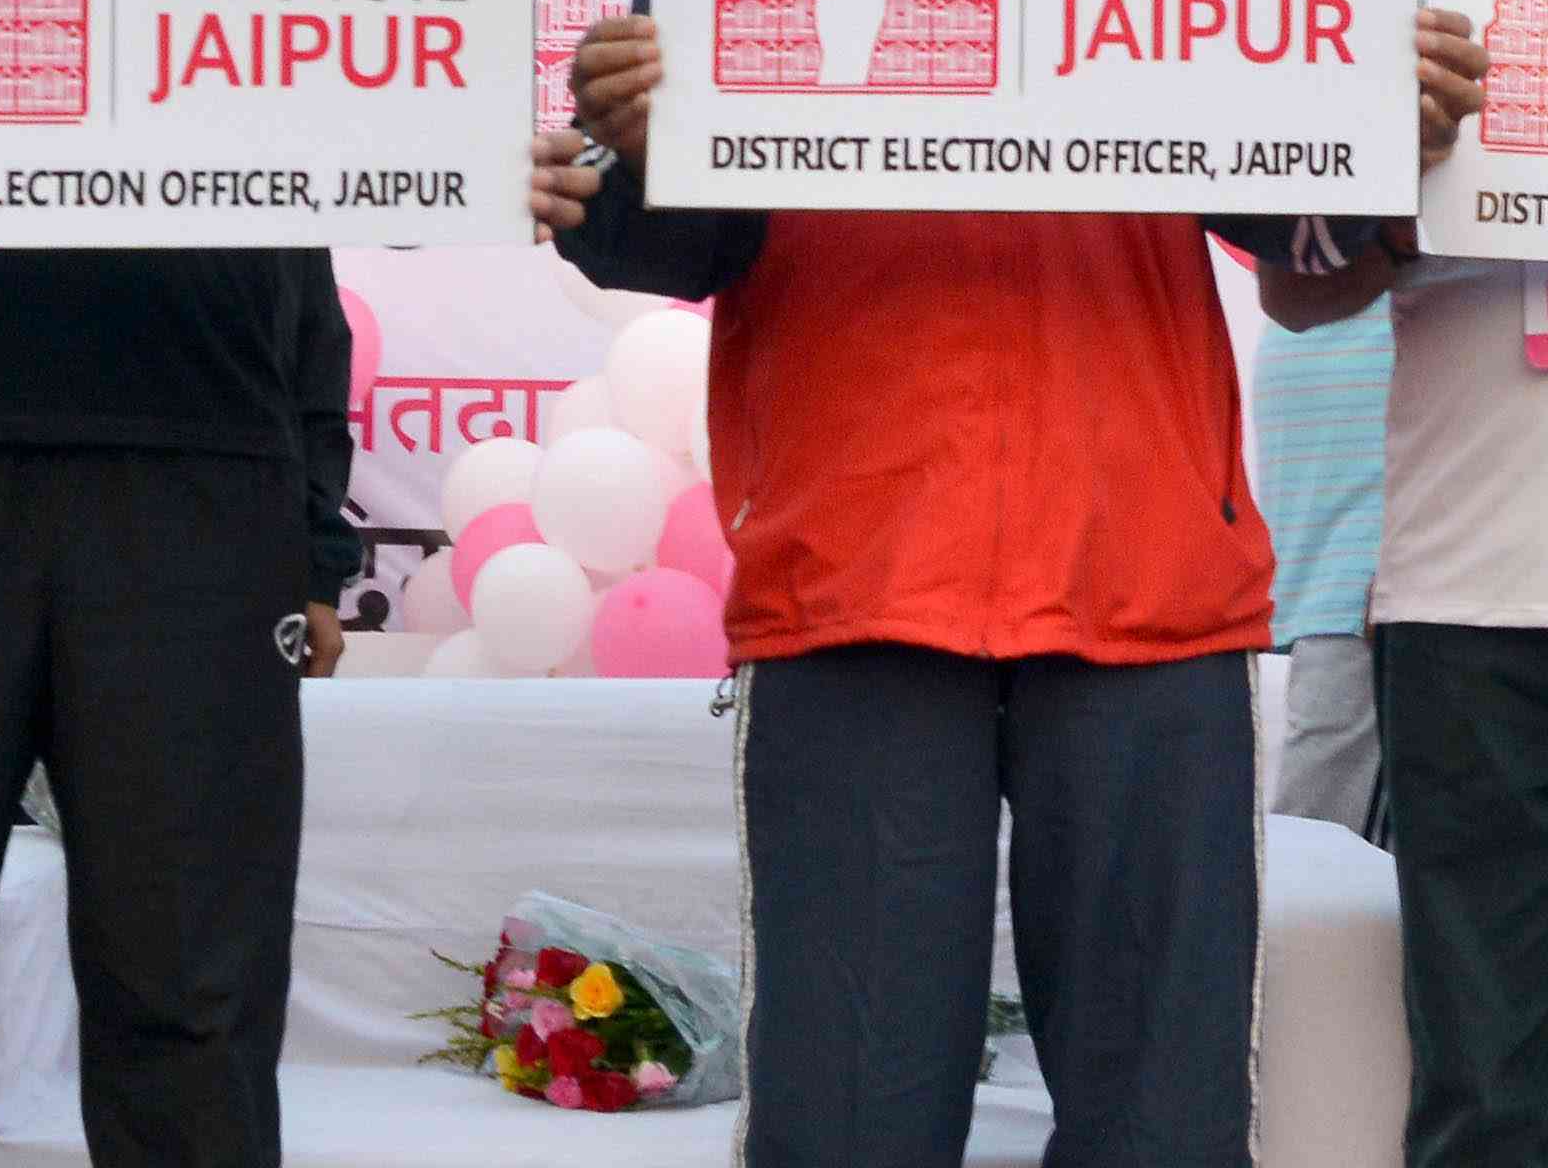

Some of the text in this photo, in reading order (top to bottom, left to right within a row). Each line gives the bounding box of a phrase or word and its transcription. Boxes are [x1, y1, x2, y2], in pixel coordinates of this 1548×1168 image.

[149, 13, 466, 104] JAIPUR
[712, 135, 1354, 180] DISTRICT ELECTION OFFICER, JAIPUR
[160, 170, 320, 212] OFFICER,
[334, 171, 466, 207] JAIPUR
